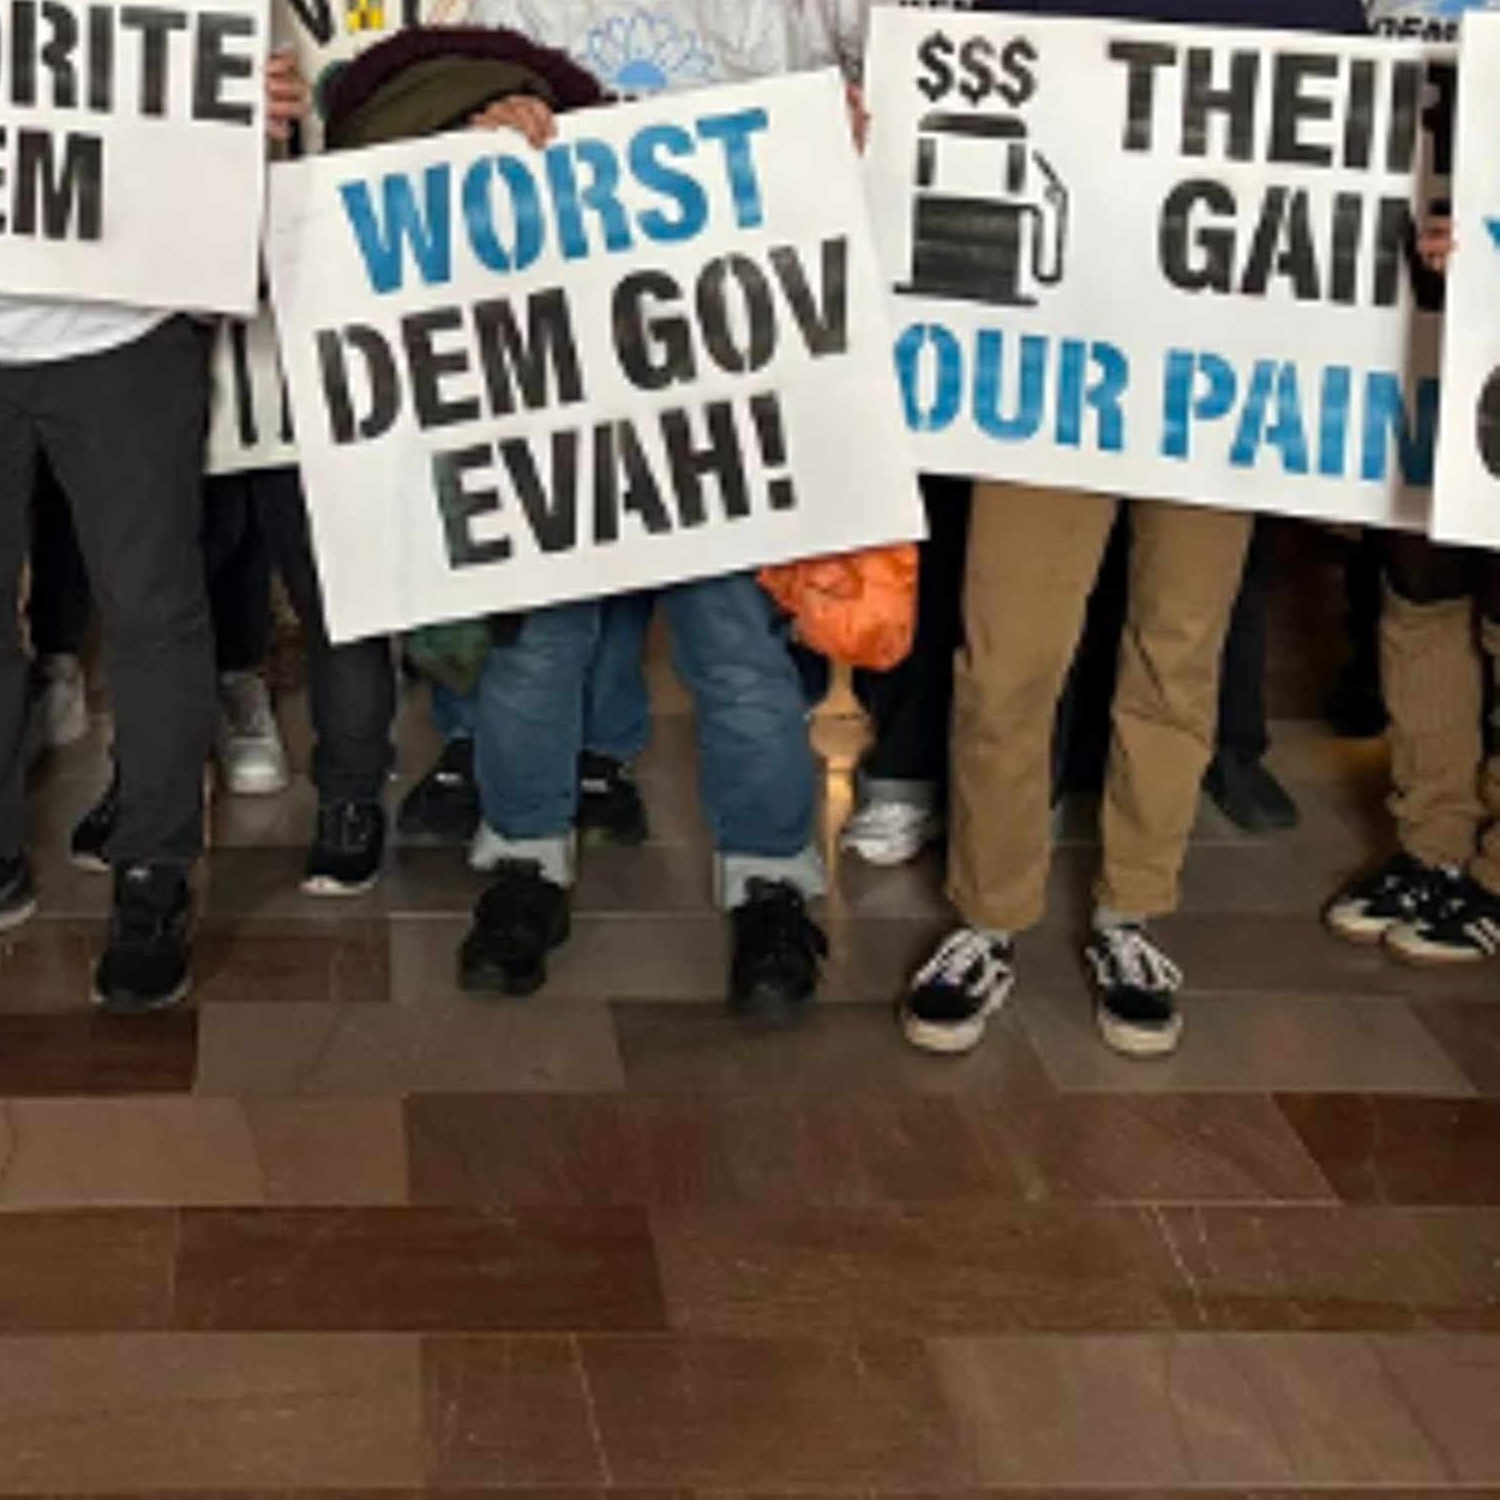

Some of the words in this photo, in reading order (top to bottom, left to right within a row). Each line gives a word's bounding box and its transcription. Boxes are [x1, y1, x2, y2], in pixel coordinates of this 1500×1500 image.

[916, 30, 1038, 107] $$$
[1107, 38, 1458, 177] THEIR
[339, 108, 769, 295] WORST
[315, 286, 586, 446] DEM
[611, 233, 850, 390] GOV
[893, 322, 1130, 454] OUR
[1160, 348, 1442, 487] PAIN
[431, 390, 797, 571] EVAH!
